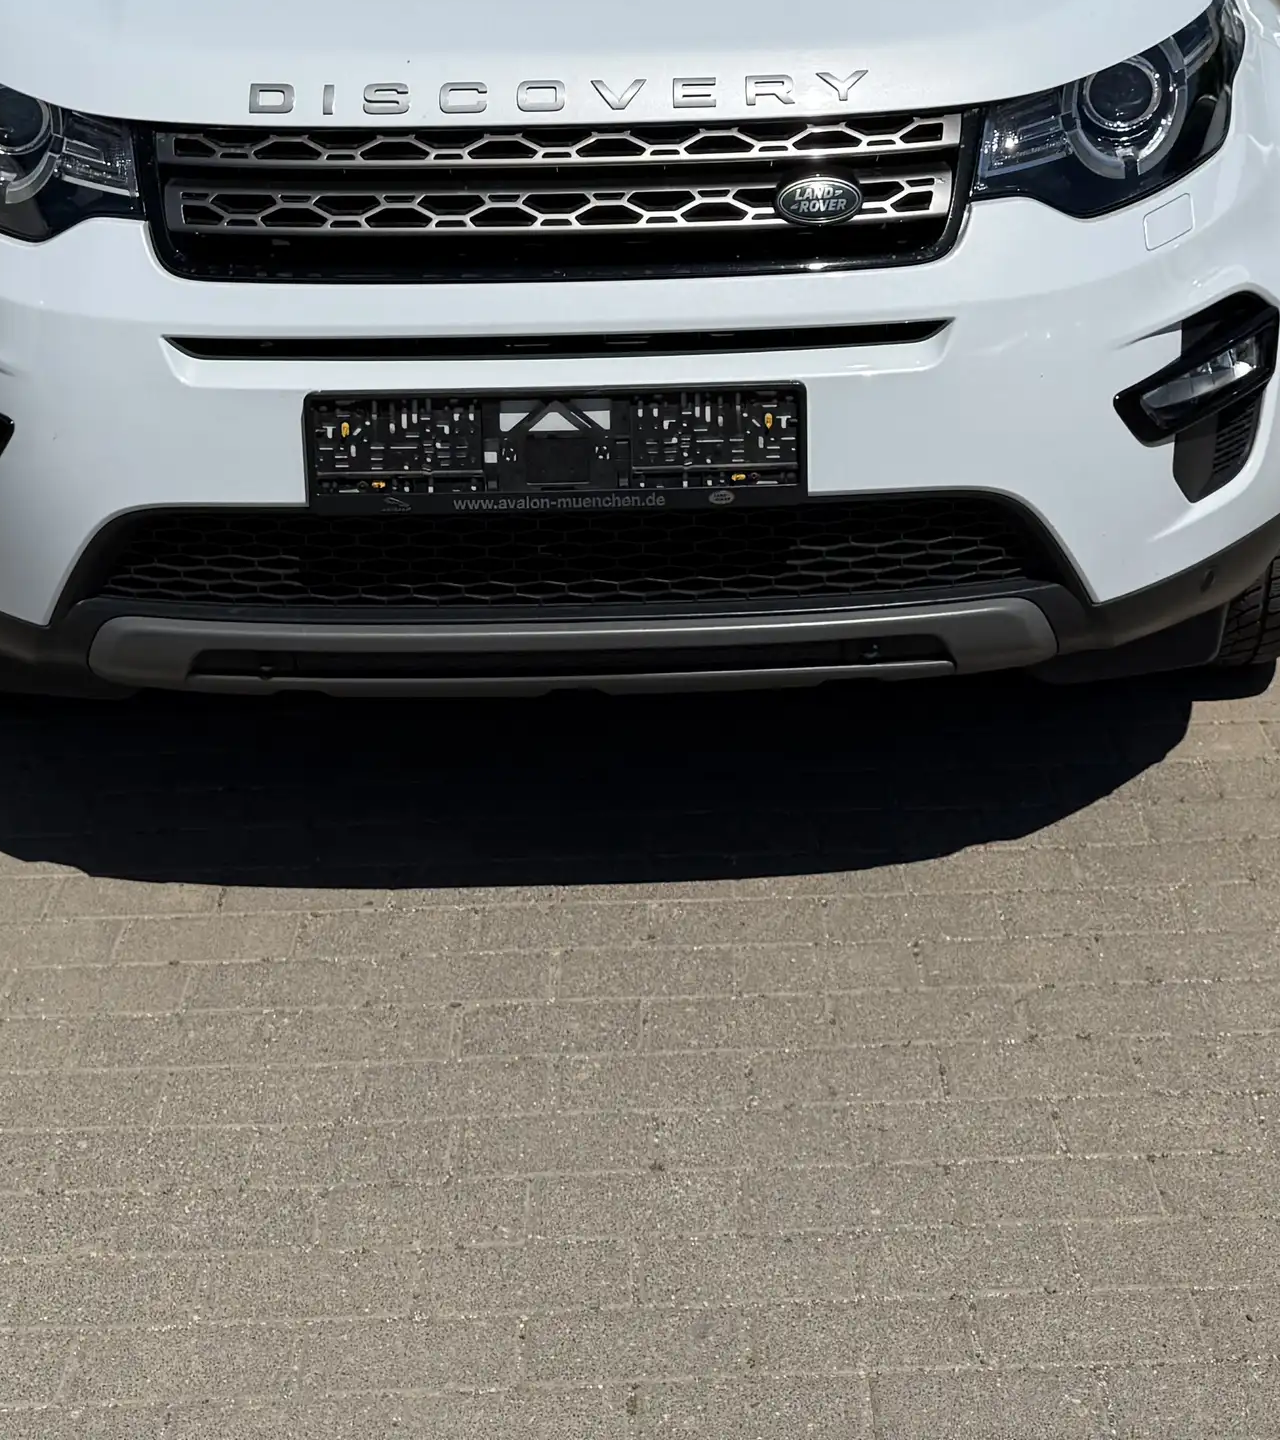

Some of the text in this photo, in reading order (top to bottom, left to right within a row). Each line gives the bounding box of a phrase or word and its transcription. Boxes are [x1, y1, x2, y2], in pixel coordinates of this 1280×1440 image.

[249, 69, 869, 116] DISCOVERY
[794, 186, 834, 201] LAND
[799, 198, 847, 213] ROVER
[453, 494, 666, 511] www.avalon-muenchen.de
